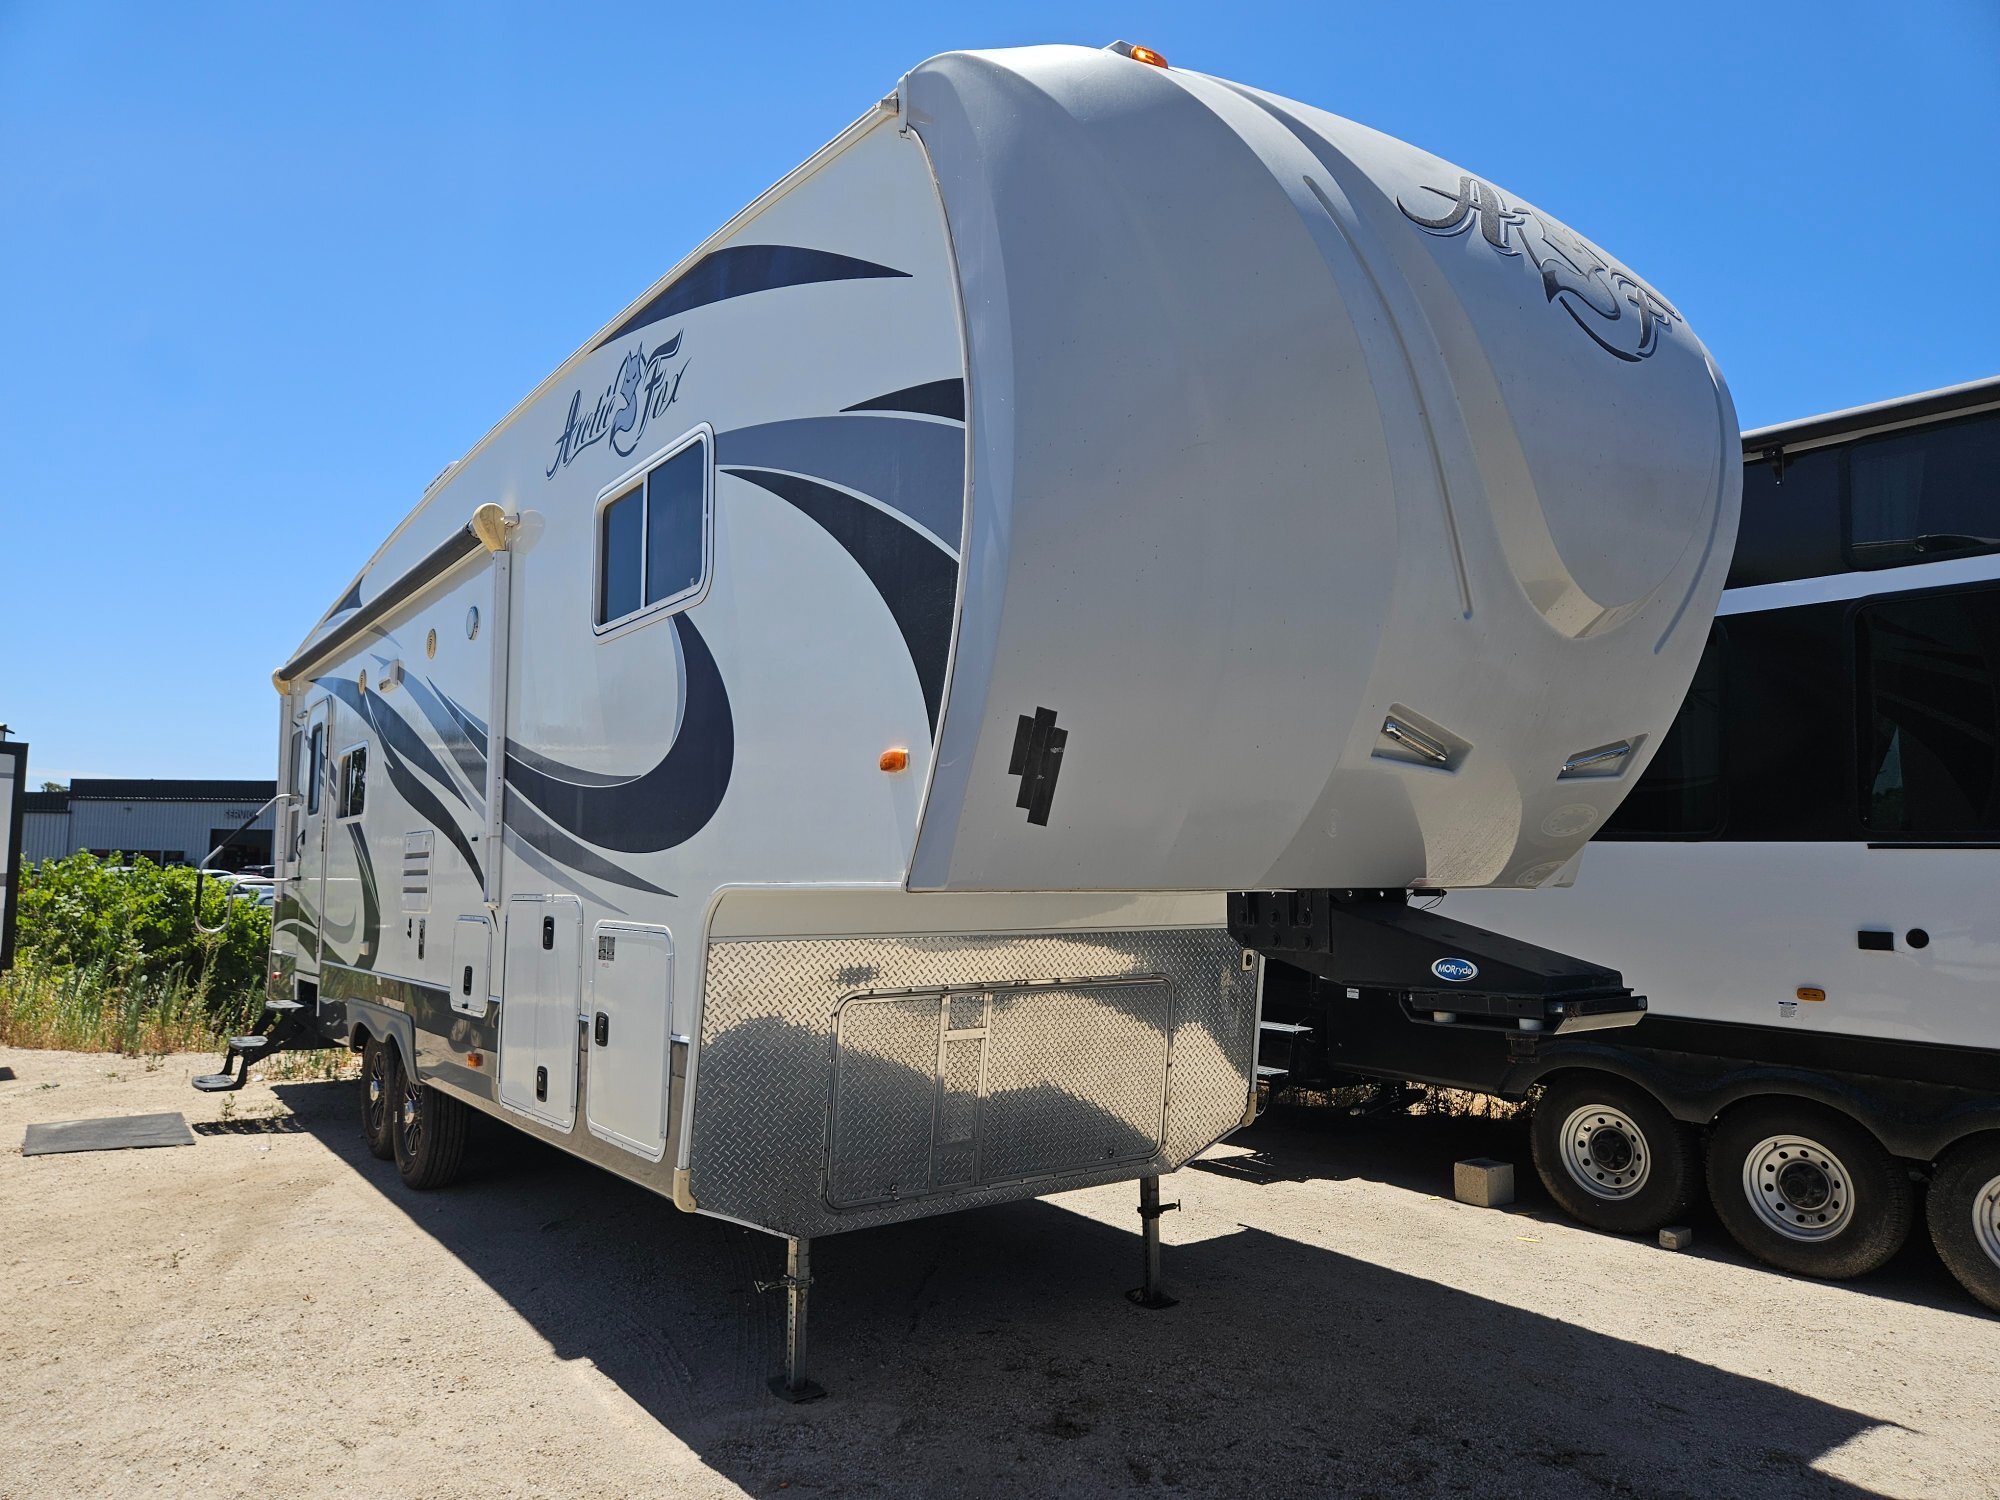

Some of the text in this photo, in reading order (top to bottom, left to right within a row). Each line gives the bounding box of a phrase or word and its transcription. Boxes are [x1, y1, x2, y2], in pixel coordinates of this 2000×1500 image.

[546, 328, 692, 481] Arctic Fox
[1438, 964, 1472, 975] MORryde
